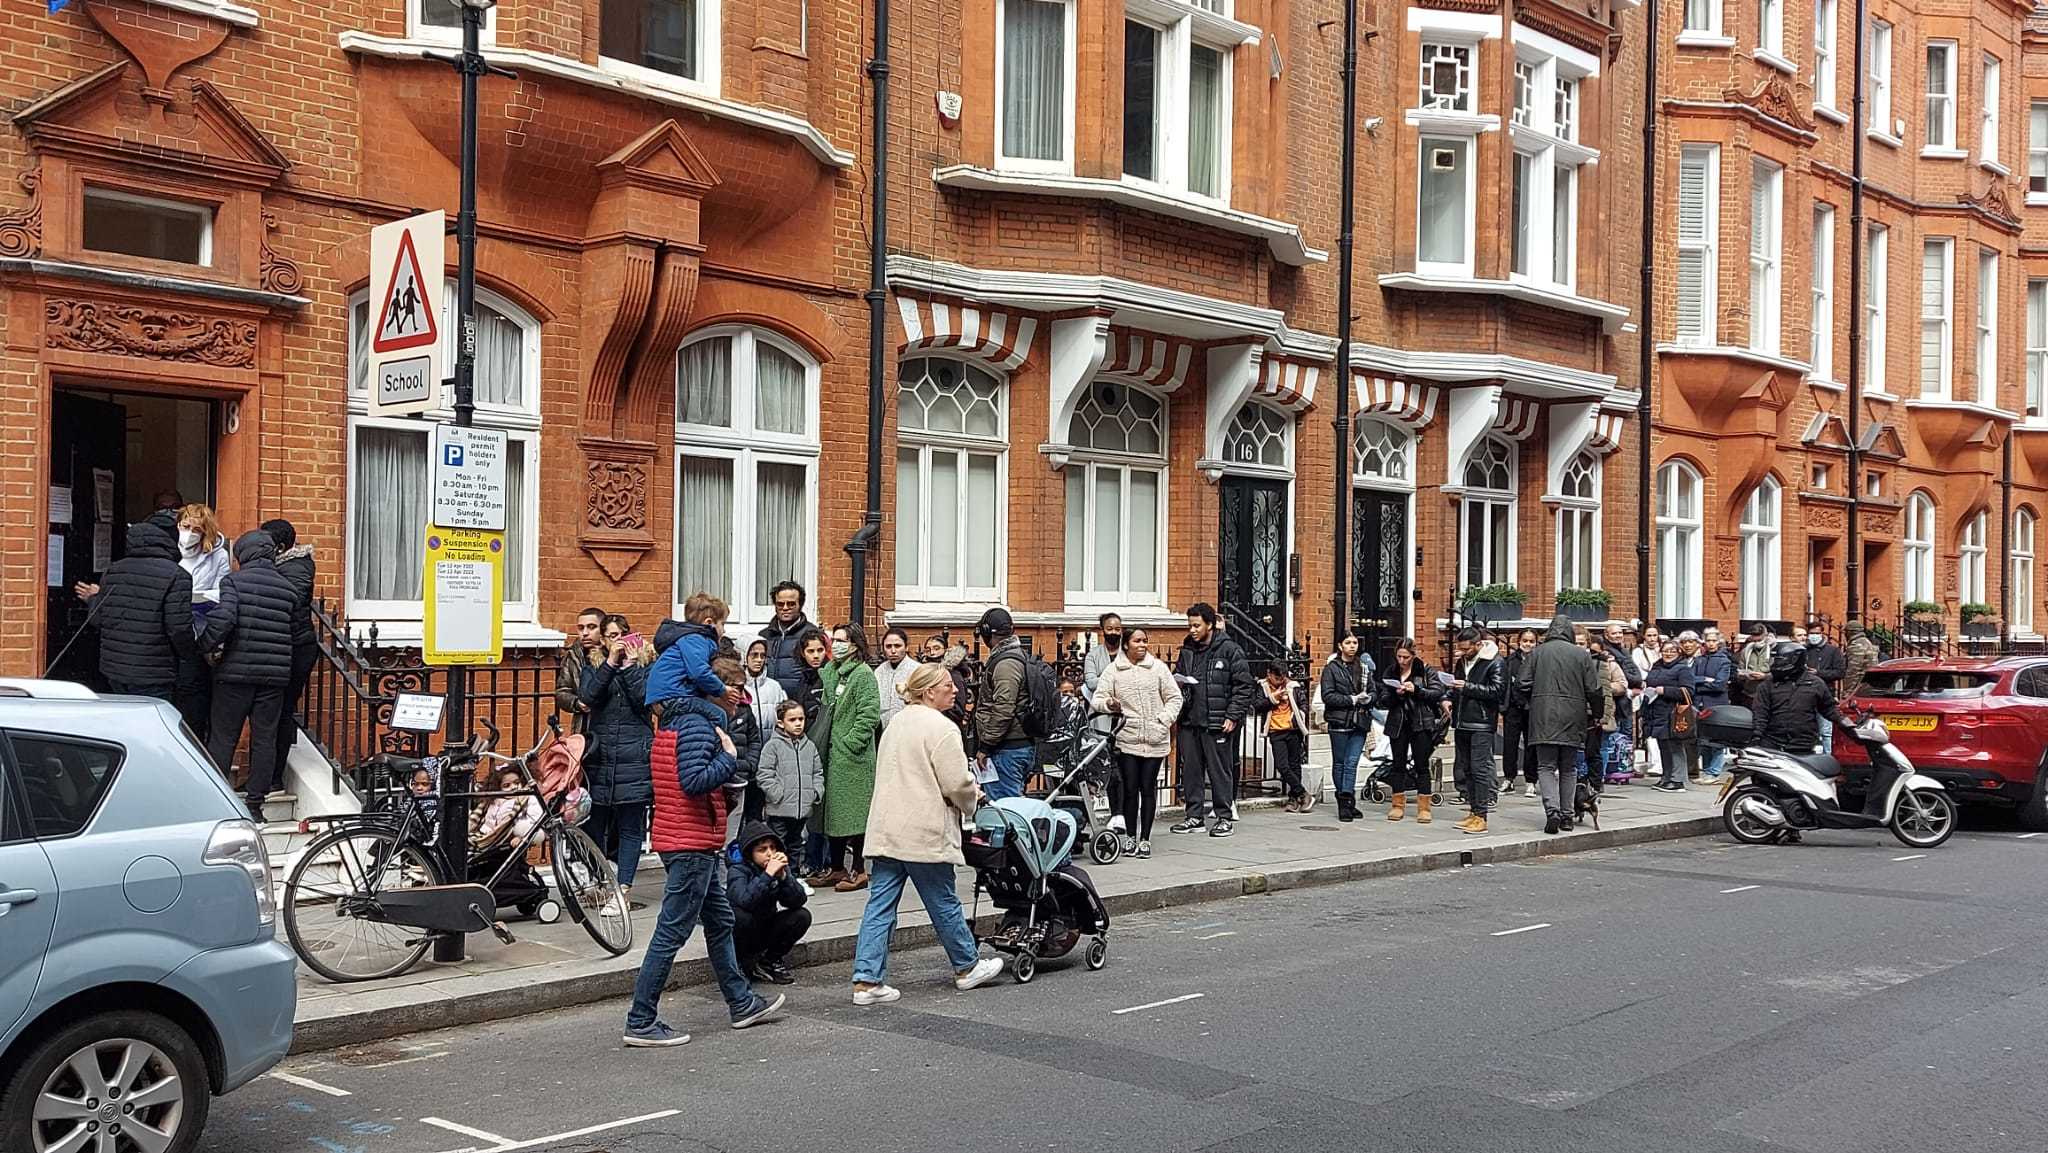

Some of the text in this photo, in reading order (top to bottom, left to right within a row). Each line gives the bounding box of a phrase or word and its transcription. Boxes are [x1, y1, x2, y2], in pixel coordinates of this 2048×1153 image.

[385, 369, 423, 392] School
[467, 432, 499, 442] Resident
[470, 443, 495, 451] permit
[1241, 443, 1253, 460] 16
[448, 446, 462, 464] P
[469, 451, 496, 459] holders
[475, 460, 491, 468] only
[1391, 461, 1401, 477] 14
[455, 473, 471, 481] Mon
[477, 474, 487, 482] Fri
[454, 490, 488, 500] Saturday
[456, 509, 484, 518] Sunday
[451, 529, 481, 538] Parking
[443, 538, 488, 549] Suspension
[444, 551, 486, 561] No Loading
